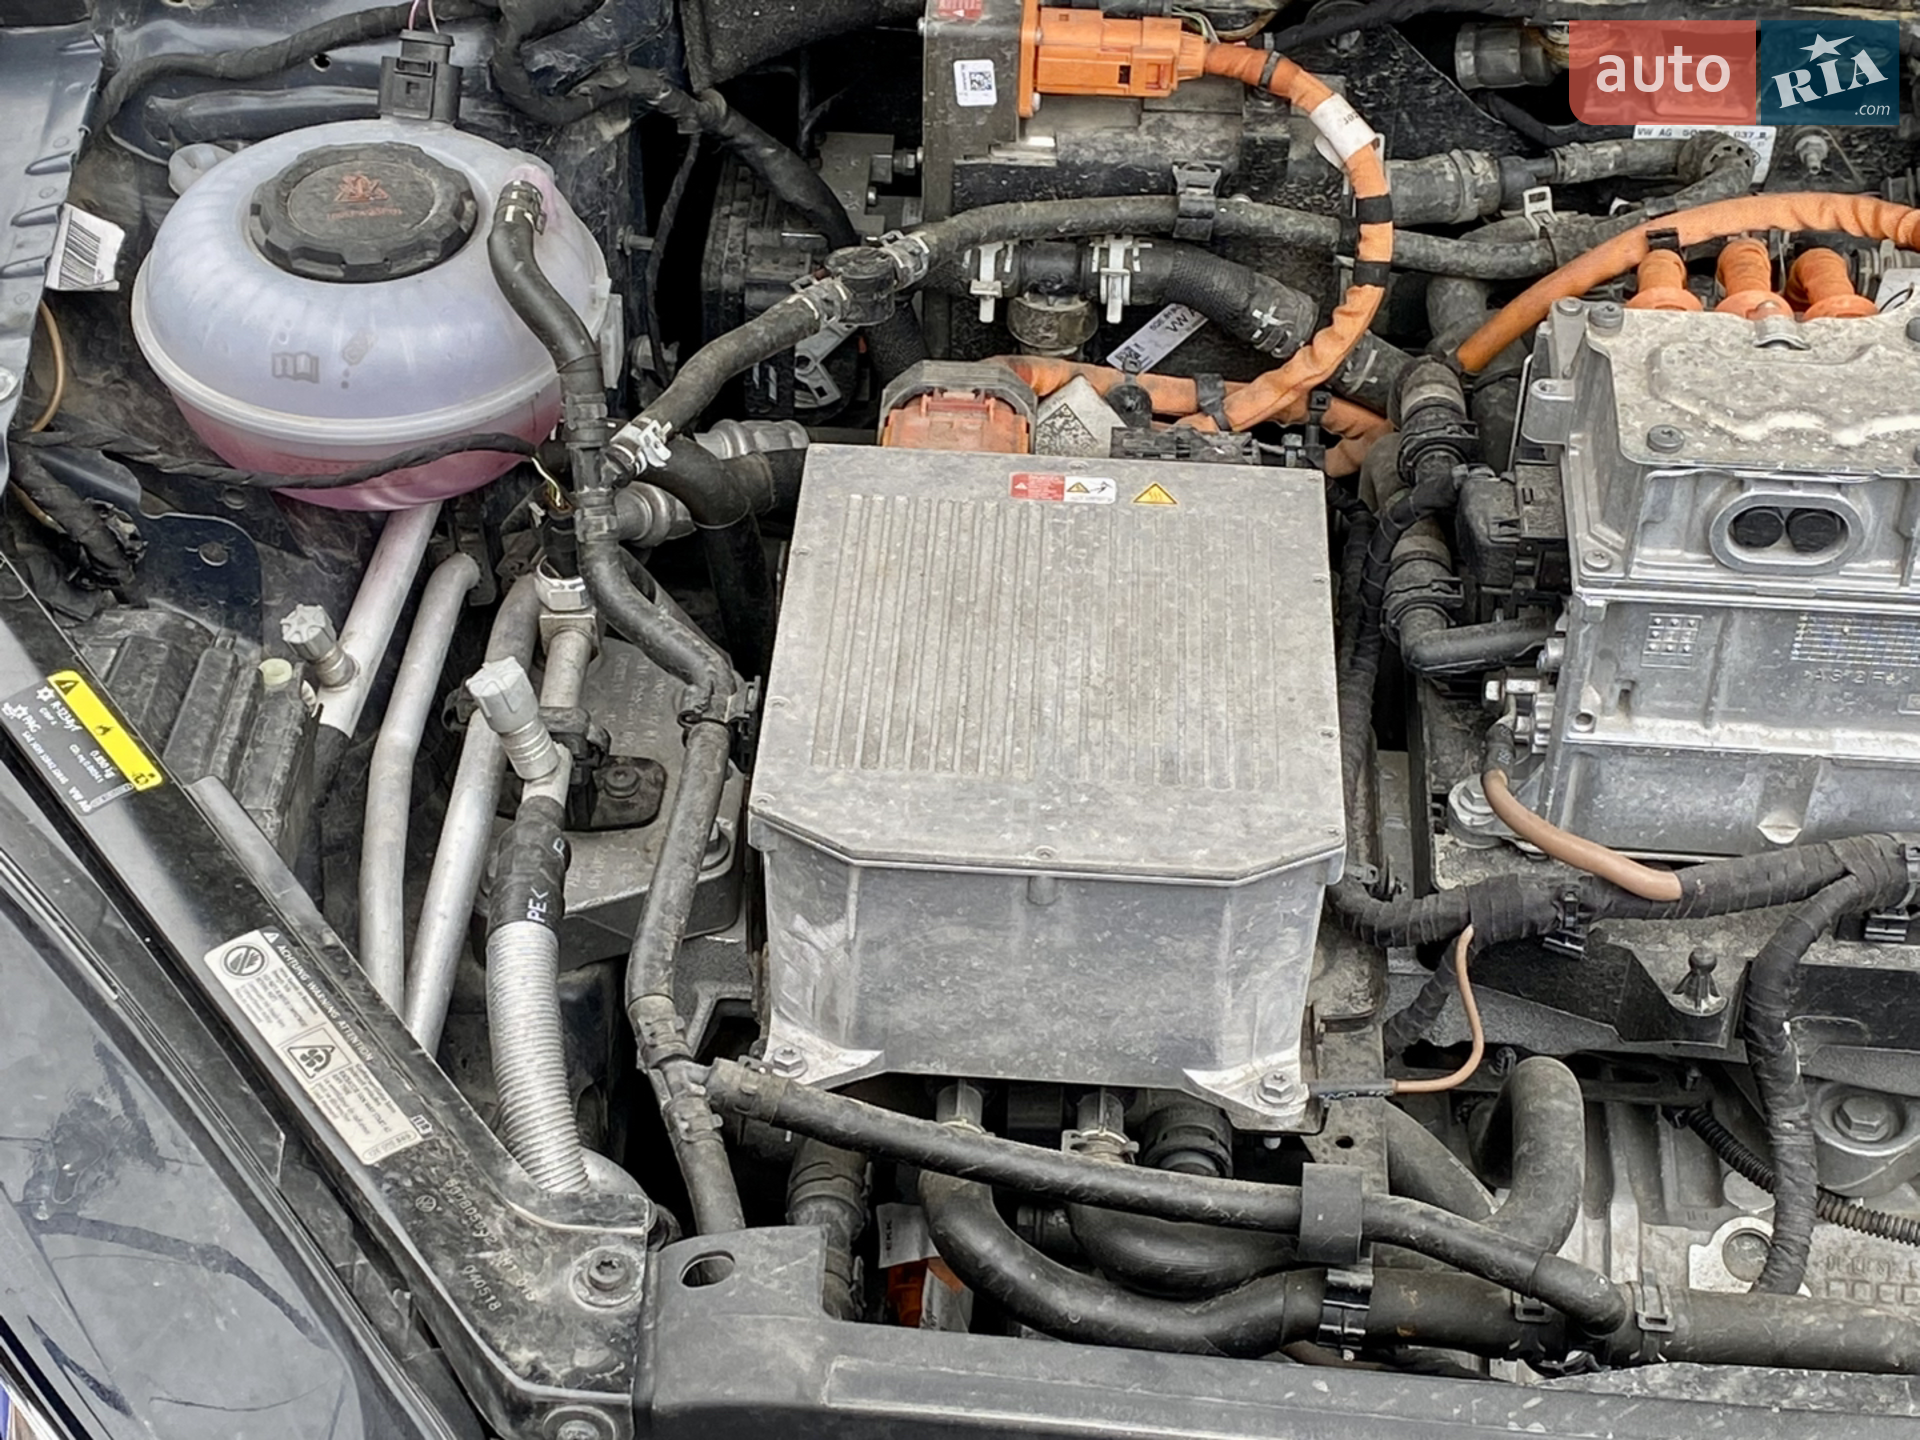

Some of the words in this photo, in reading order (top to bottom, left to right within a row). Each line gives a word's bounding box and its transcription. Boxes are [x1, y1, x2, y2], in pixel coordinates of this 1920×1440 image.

[1637, 128, 1653, 136] VW
[1659, 128, 1673, 137] AG
[1165, 313, 1189, 332] VW
[68, 786, 84, 801] VW
[276, 944, 310, 983] ACHTUNG
[306, 979, 342, 1019] WARNING
[337, 1018, 375, 1062] ATTENTION
